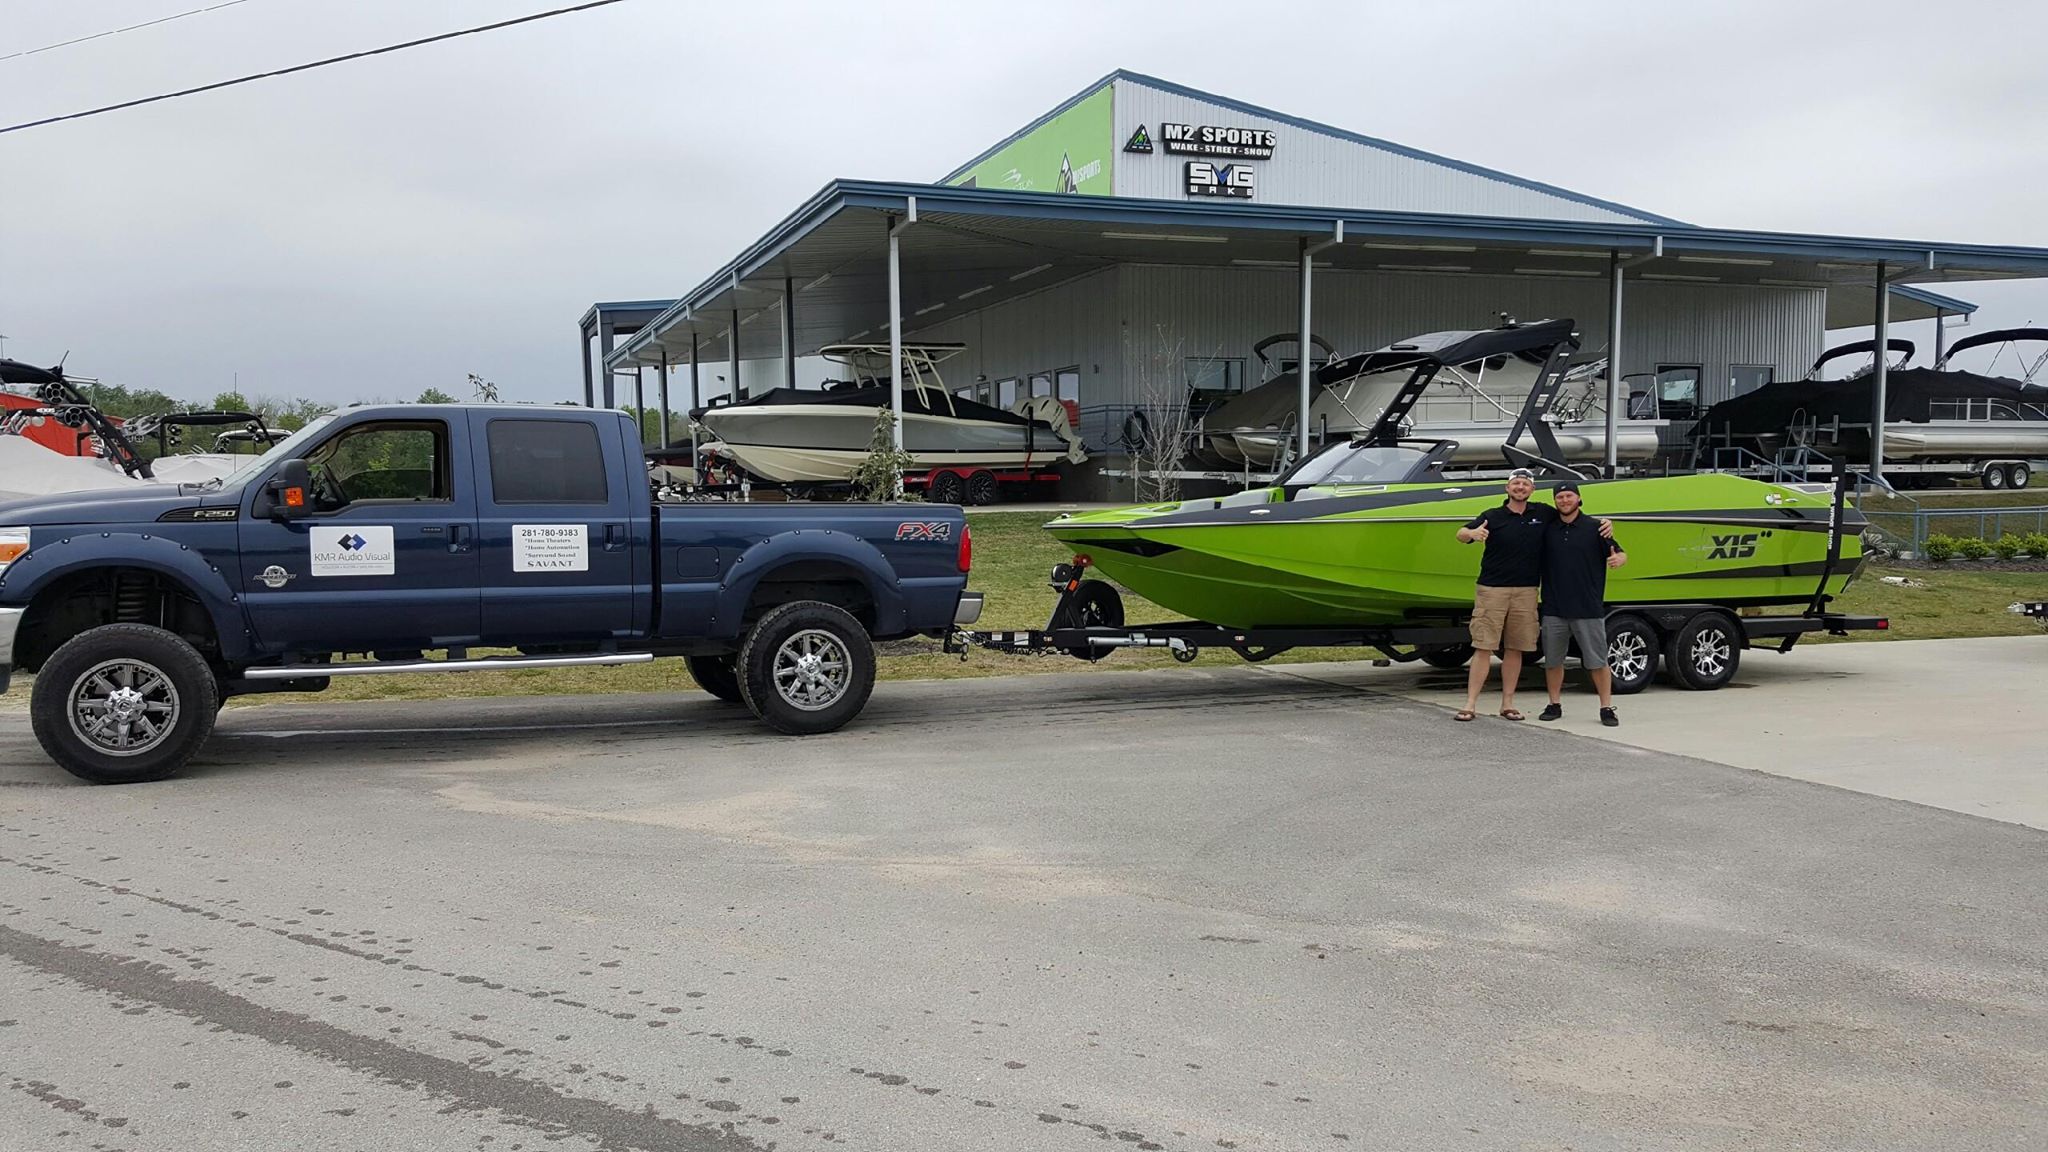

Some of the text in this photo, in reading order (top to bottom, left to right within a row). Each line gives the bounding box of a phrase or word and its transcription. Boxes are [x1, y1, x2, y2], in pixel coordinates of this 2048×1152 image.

[1165, 124, 1277, 147] M2 SPORTS
[1170, 142, 1199, 151] WAKE
[1204, 145, 1237, 154] STREET
[1244, 147, 1273, 157] SNOW
[1190, 162, 1254, 187] SMG
[1190, 185, 1254, 196] WAKE
[895, 522, 951, 538] FX4
[314, 552, 391, 561] KMR Audio Visual
